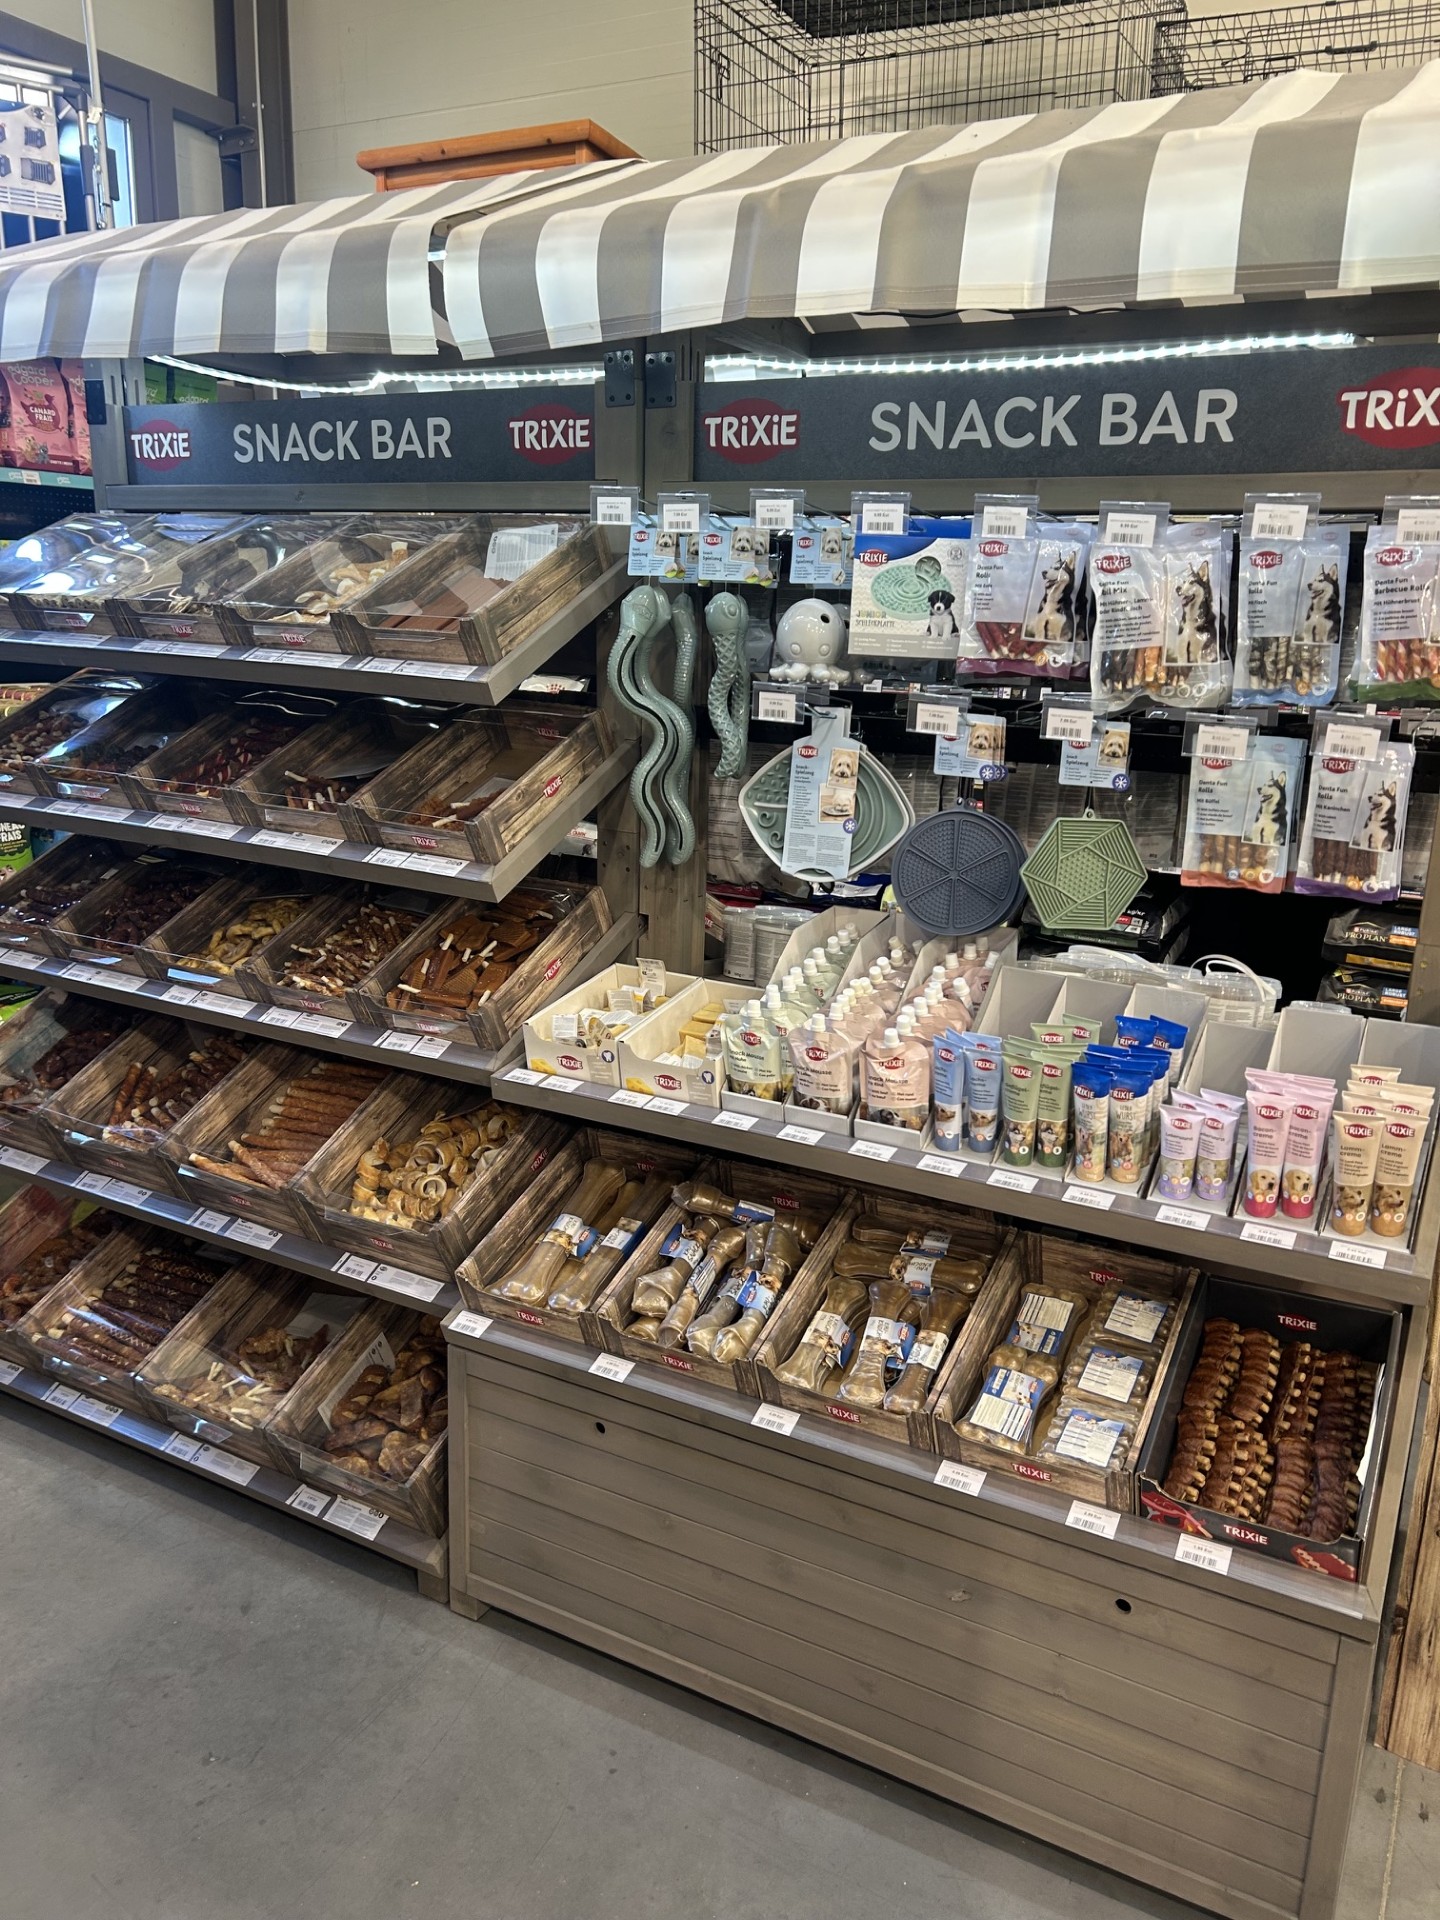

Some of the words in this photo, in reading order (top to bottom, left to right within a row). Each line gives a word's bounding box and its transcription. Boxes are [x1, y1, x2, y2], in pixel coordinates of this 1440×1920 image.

[29, 405, 57, 417] CANARD
[34, 413, 54, 423] FRAIS
[869, 394, 1080, 453] SNACK
[1098, 388, 1240, 446] BAR
[509, 417, 591, 451] TRiXiE
[704, 413, 798, 450] TRiXiE
[130, 431, 191, 460] TRiXiE
[232, 417, 363, 465] SNACK
[370, 415, 453, 461] BAR
[703, 535, 723, 545] TRIXIE
[979, 542, 1009, 554] TRIXIE
[858, 552, 889, 564] TRIXIE
[1374, 585, 1409, 596] Barbecue
[1336, 786, 1348, 794] Fun
[1345, 931, 1362, 940] PRO
[1362, 933, 1387, 943] PLAN
[1336, 992, 1354, 1001] PRO
[1354, 994, 1379, 1004] PLAN
[1073, 1027, 1091, 1038] RIXIE
[1199, 1132, 1226, 1142] eberwurst
[1278, 1314, 1318, 1331] TRiXiE
[1011, 1462, 1052, 1482] TRiXiE
[1222, 1523, 1269, 1545] TRiXiE
